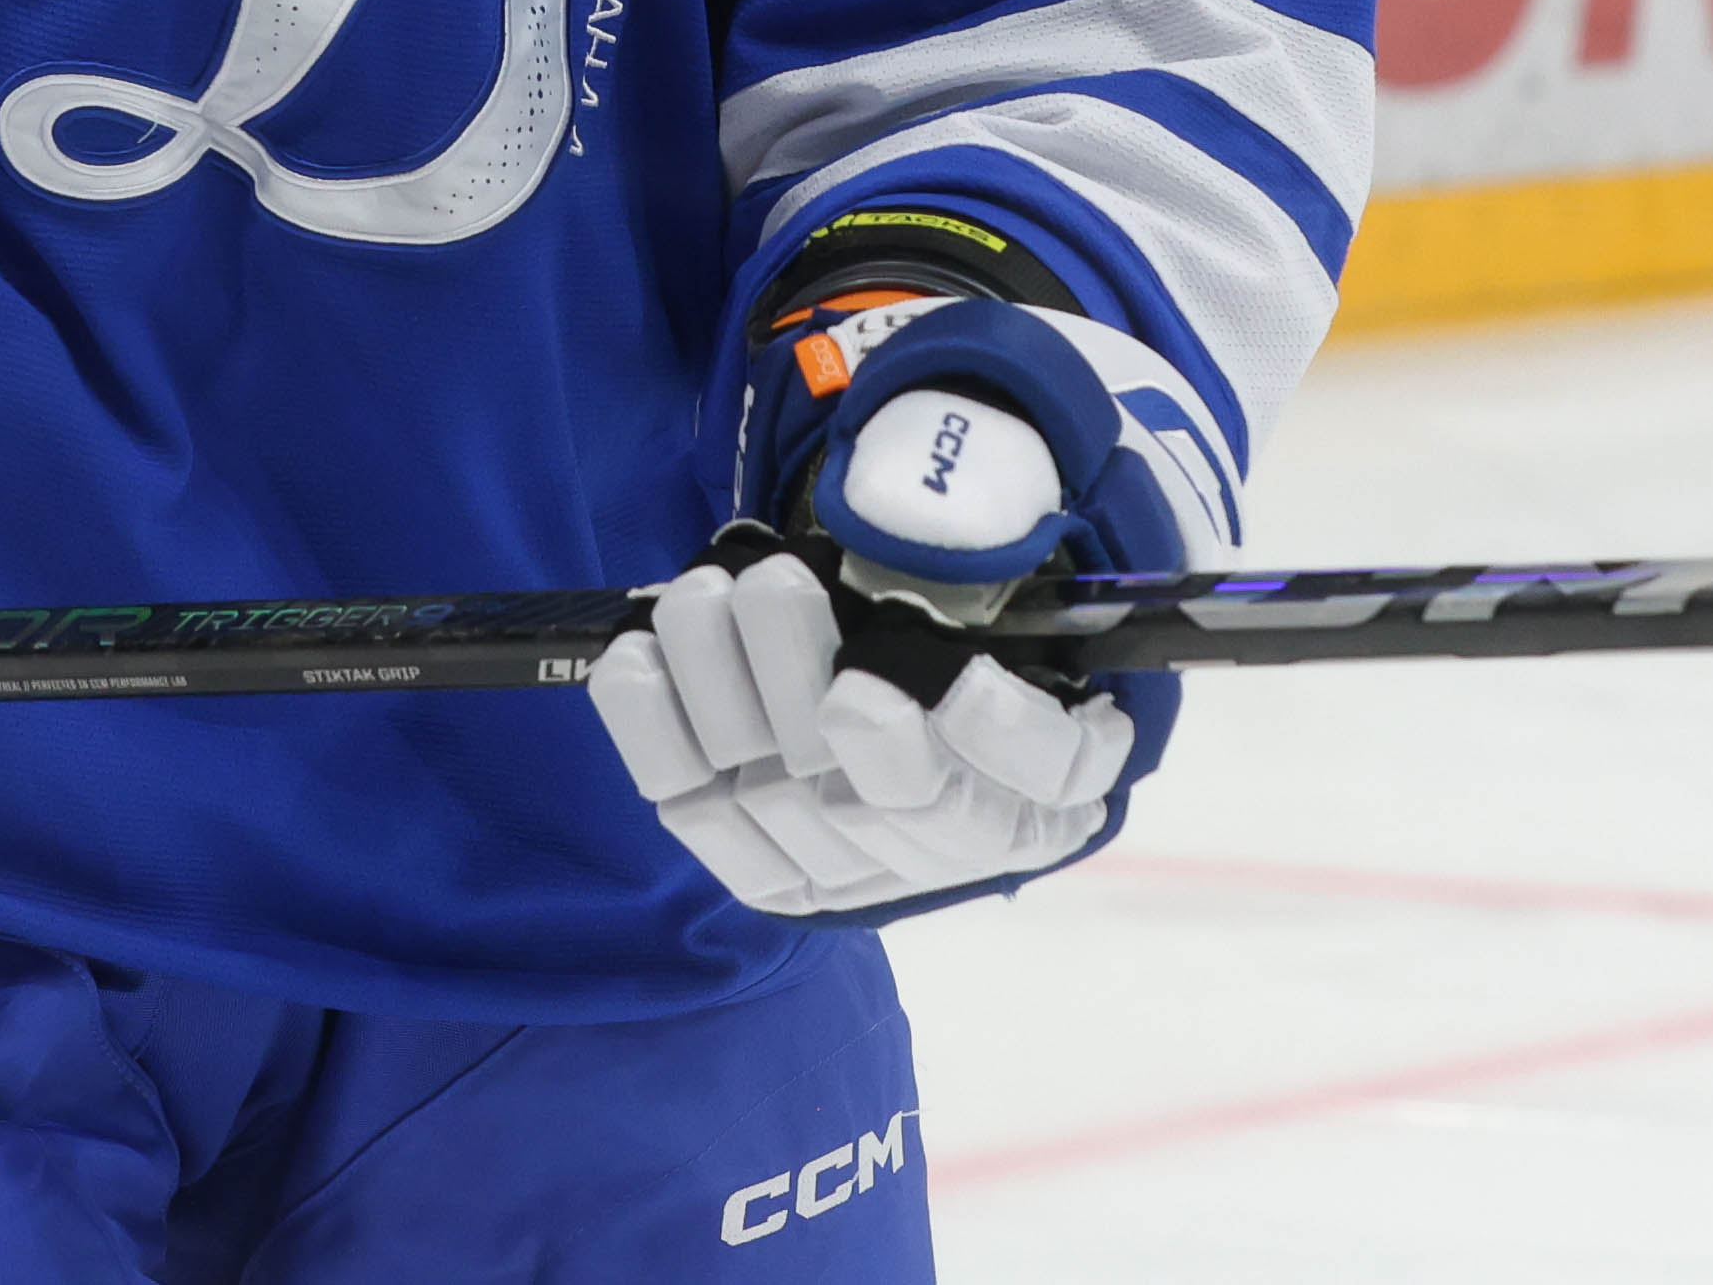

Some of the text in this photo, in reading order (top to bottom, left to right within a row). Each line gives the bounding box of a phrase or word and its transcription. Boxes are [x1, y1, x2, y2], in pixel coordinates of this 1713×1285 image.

[922, 412, 971, 496] CCM
[173, 604, 408, 632] TRIGGER
[303, 666, 420, 684] STIKTAK GRIP
[720, 1110, 905, 1248] CCM
